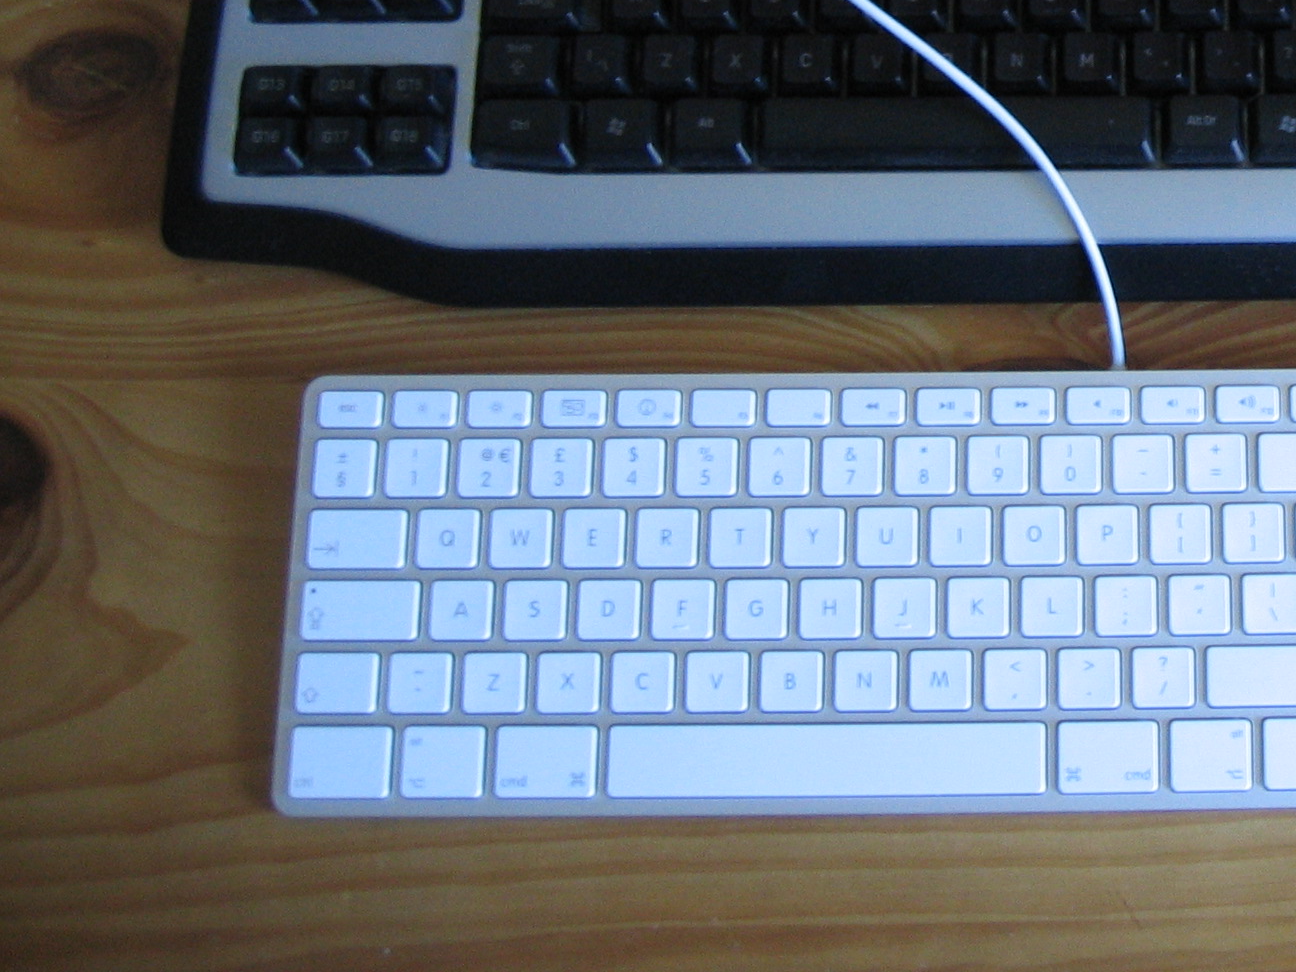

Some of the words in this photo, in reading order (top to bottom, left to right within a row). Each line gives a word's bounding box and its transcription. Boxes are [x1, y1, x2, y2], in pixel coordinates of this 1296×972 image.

[481, 471, 491, 487] 2
[554, 471, 564, 487] 3
[626, 470, 637, 485] 4
[700, 469, 710, 486] 5
[773, 471, 783, 485] 6
[847, 469, 856, 484] 7
[919, 469, 929, 484] 8
[993, 467, 1003, 482] 9
[1065, 466, 1076, 482] 0
[439, 530, 455, 547] Q
[511, 530, 530, 546] W
[588, 529, 597, 547] E
[661, 529, 672, 545] R
[735, 528, 744, 544] T
[808, 529, 818, 544] Y
[879, 529, 893, 545] U
[1102, 525, 1113, 541] P
[453, 602, 468, 617] A
[529, 601, 540, 618] S
[601, 600, 615, 617] D
[677, 600, 687, 616] F
[748, 600, 763, 617] G
[823, 601, 837, 615] H
[899, 600, 907, 617] J
[971, 599, 983, 614] K
[1047, 598, 1057, 614] L
[487, 673, 500, 692] Z
[561, 674, 574, 689] X
[635, 673, 648, 691] C
[711, 674, 723, 689] V
[785, 673, 796, 690] B
[858, 673, 872, 688] N
[930, 671, 949, 687] M
